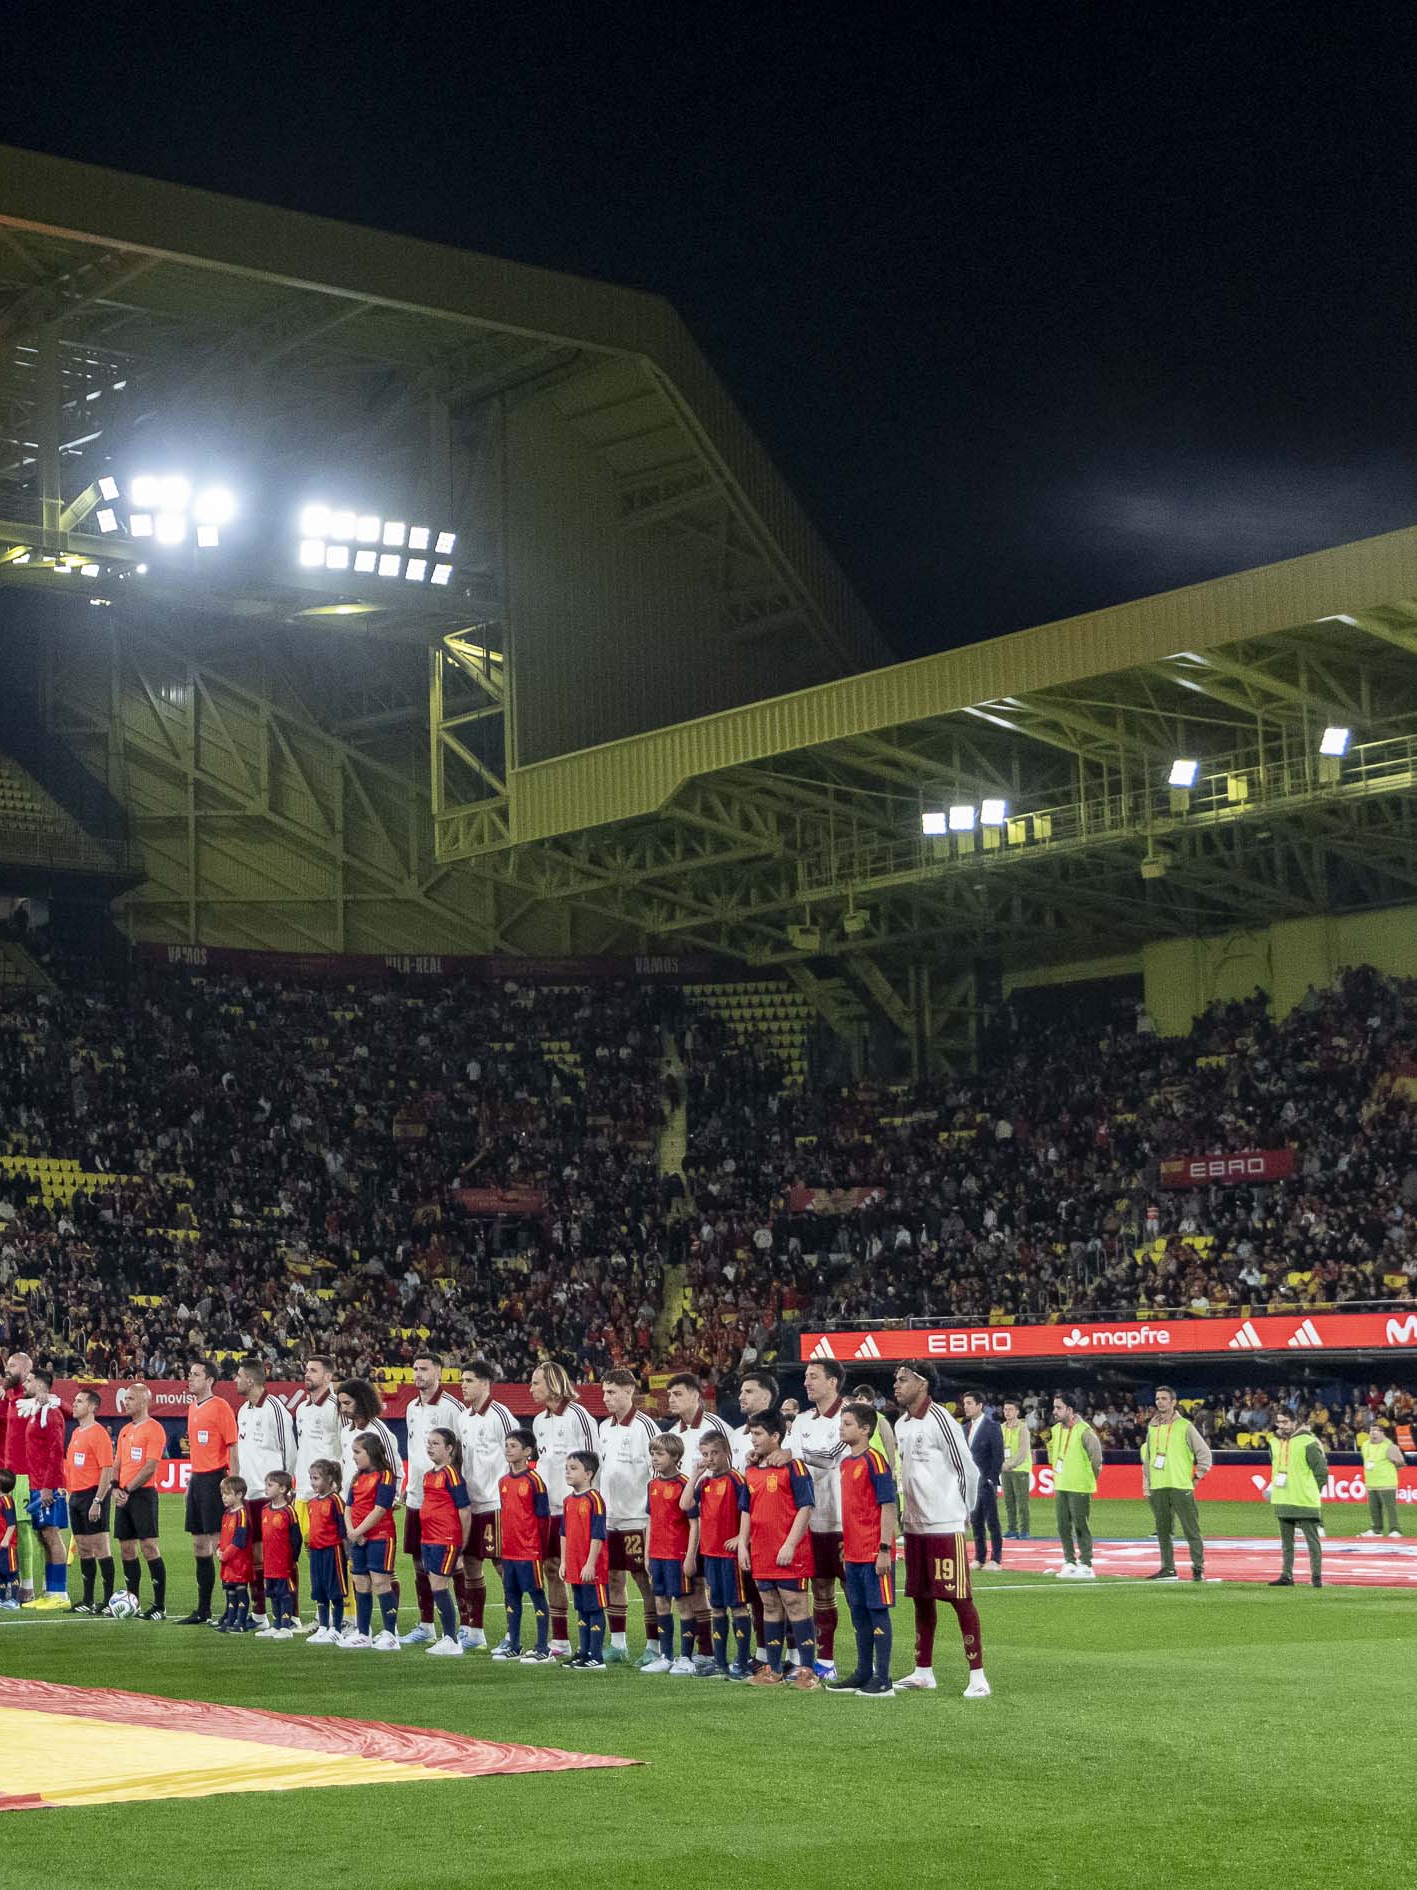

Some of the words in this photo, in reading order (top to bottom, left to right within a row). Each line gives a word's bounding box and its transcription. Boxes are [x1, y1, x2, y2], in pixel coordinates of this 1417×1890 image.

[1189, 1157, 1264, 1177] EBRO
[927, 1332, 1012, 1353] EBRO
[1092, 1326, 1170, 1348] mapfre
[484, 1523, 494, 1543] 4
[623, 1535, 643, 1555] 22
[934, 1557, 955, 1581] 19
